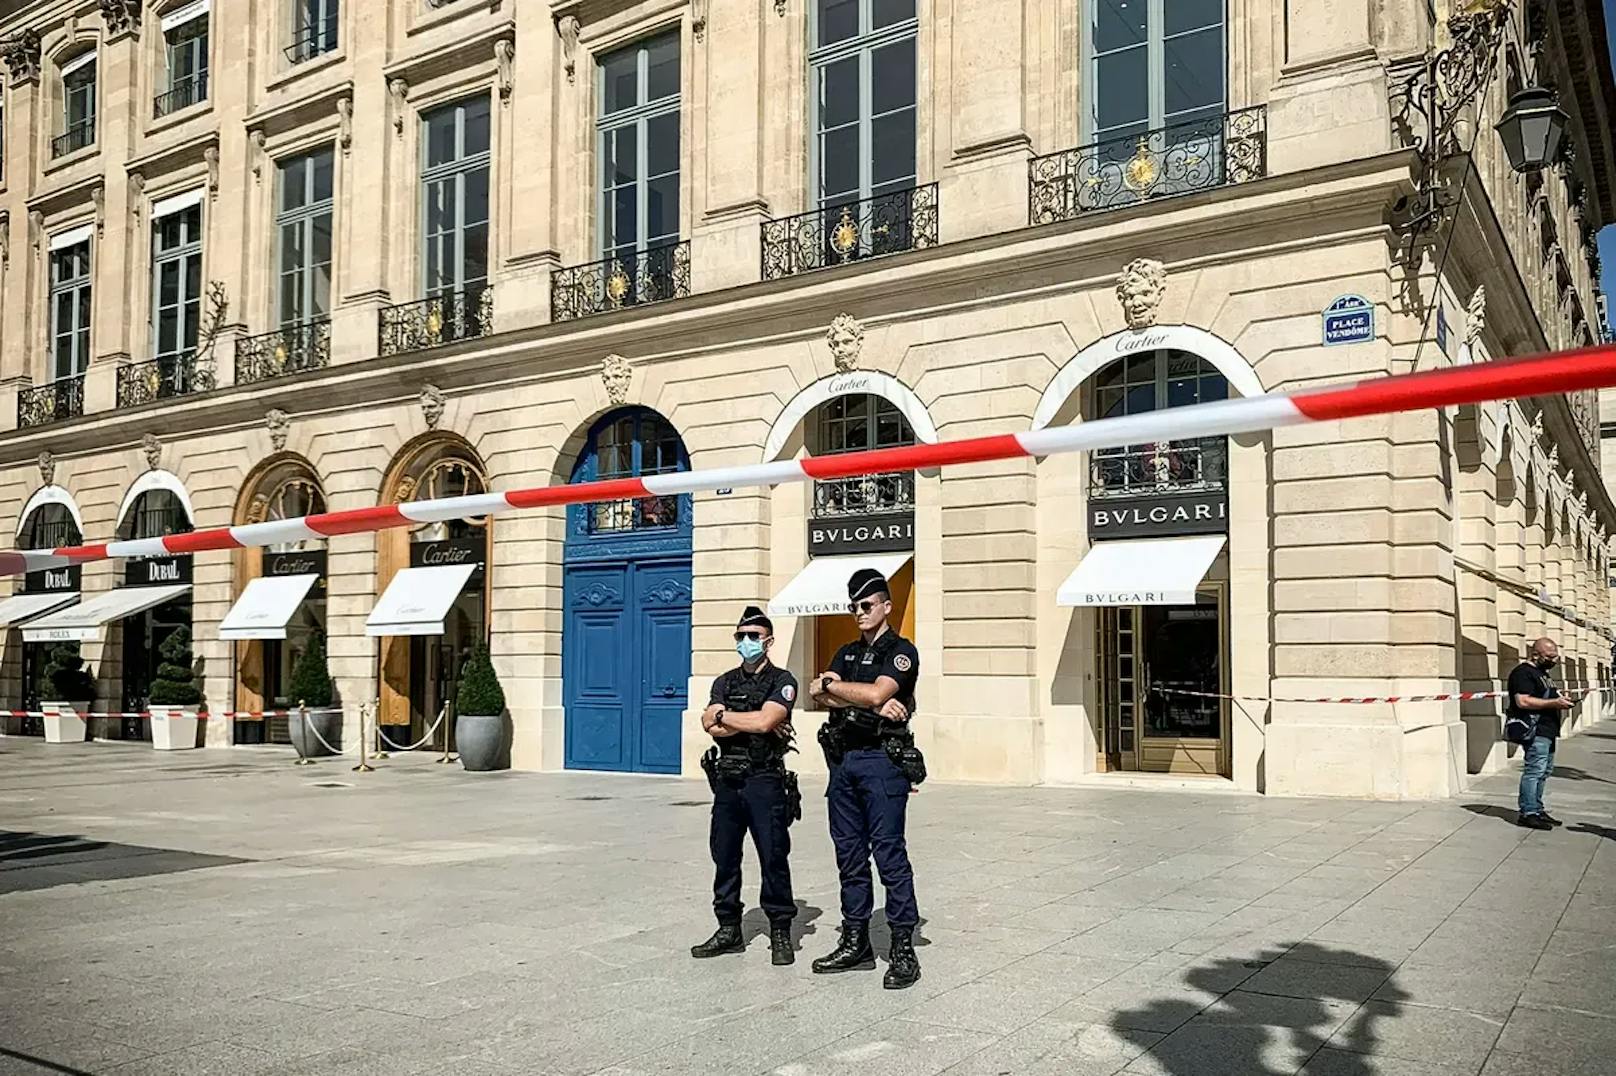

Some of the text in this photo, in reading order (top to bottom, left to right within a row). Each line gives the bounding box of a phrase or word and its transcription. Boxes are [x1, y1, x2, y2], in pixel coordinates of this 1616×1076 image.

[1332, 317, 1364, 329] PLACE
[1327, 326, 1370, 338] VENDÔME
[1115, 333, 1169, 353] Cartier
[828, 378, 869, 393] Cartier
[1093, 502, 1225, 527] BVLGARI
[812, 524, 912, 544] BVLGARI
[422, 543, 472, 564] Cartier
[272, 555, 316, 574] Cartier
[1085, 592, 1165, 603] BVLGARI
[788, 602, 847, 614] BVLGARI
